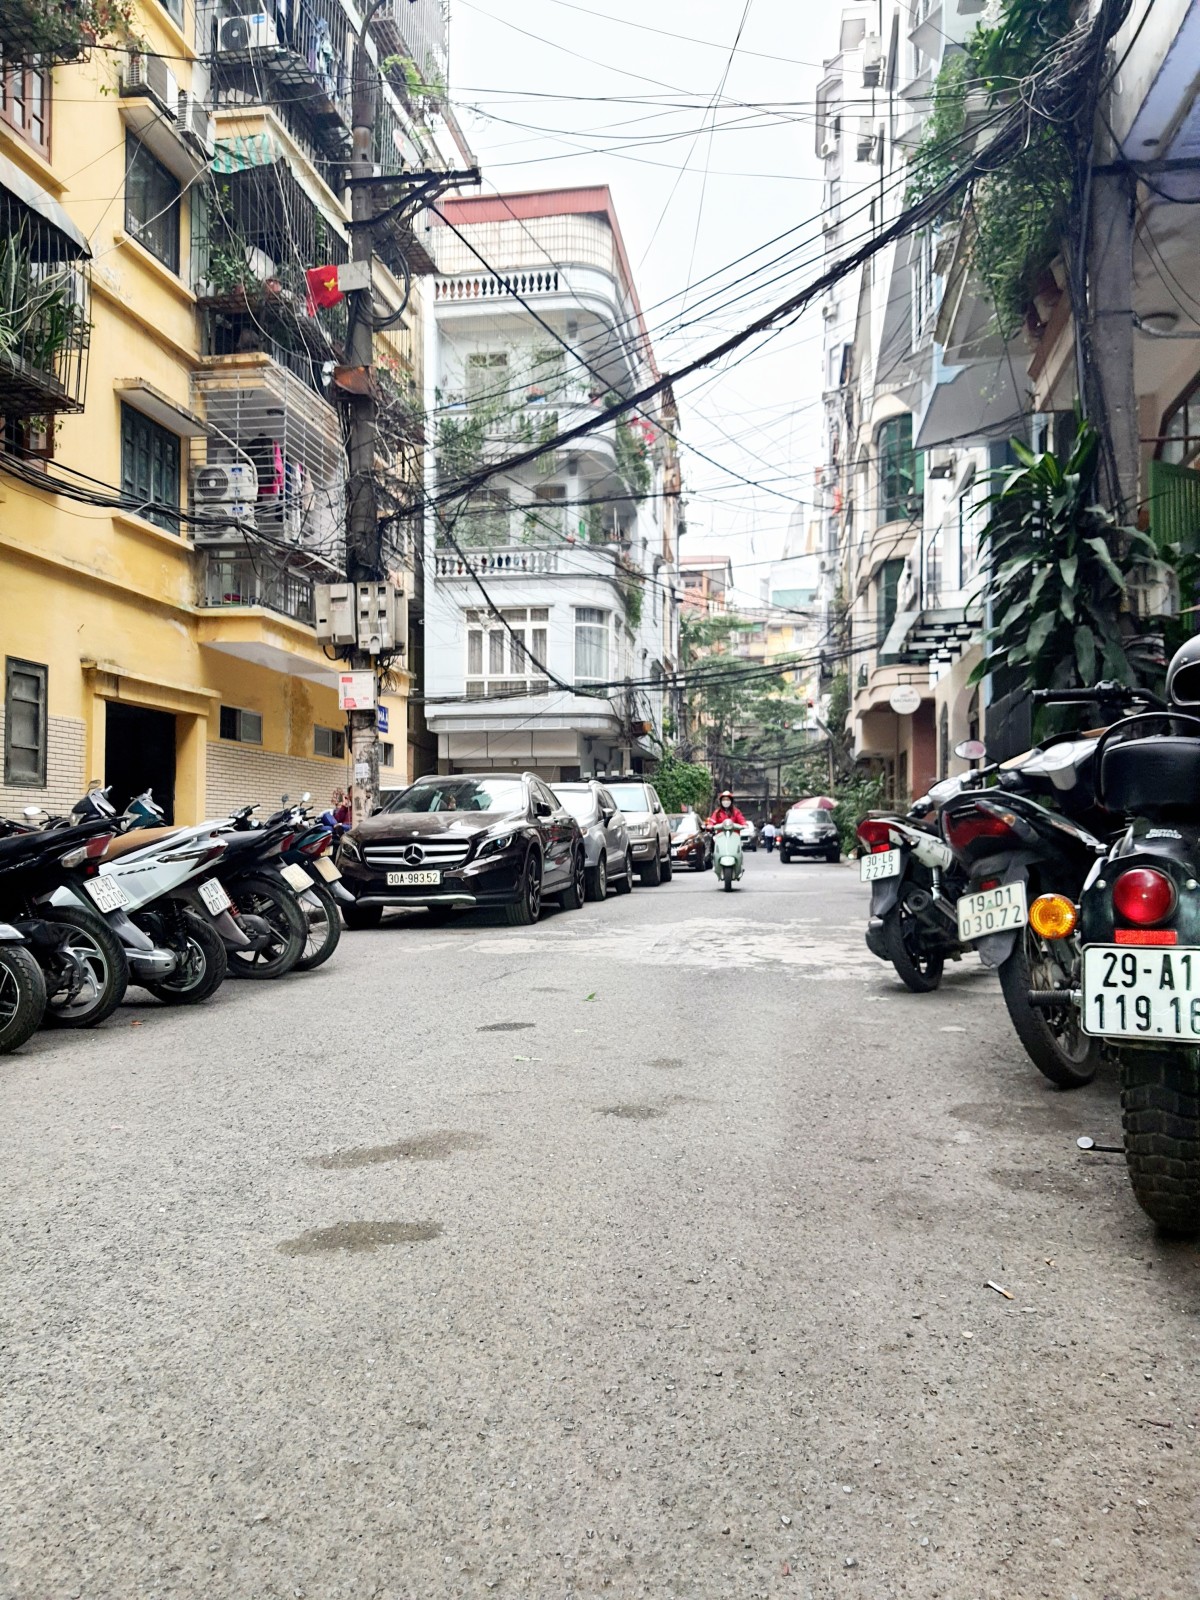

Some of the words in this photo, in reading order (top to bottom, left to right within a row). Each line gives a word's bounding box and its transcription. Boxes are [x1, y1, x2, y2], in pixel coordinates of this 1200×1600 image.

[866, 852, 894, 867] 30-L6
[866, 863, 893, 879] 2273
[962, 905, 1022, 936] 030.72
[1102, 952, 1192, 991] 29-A1
